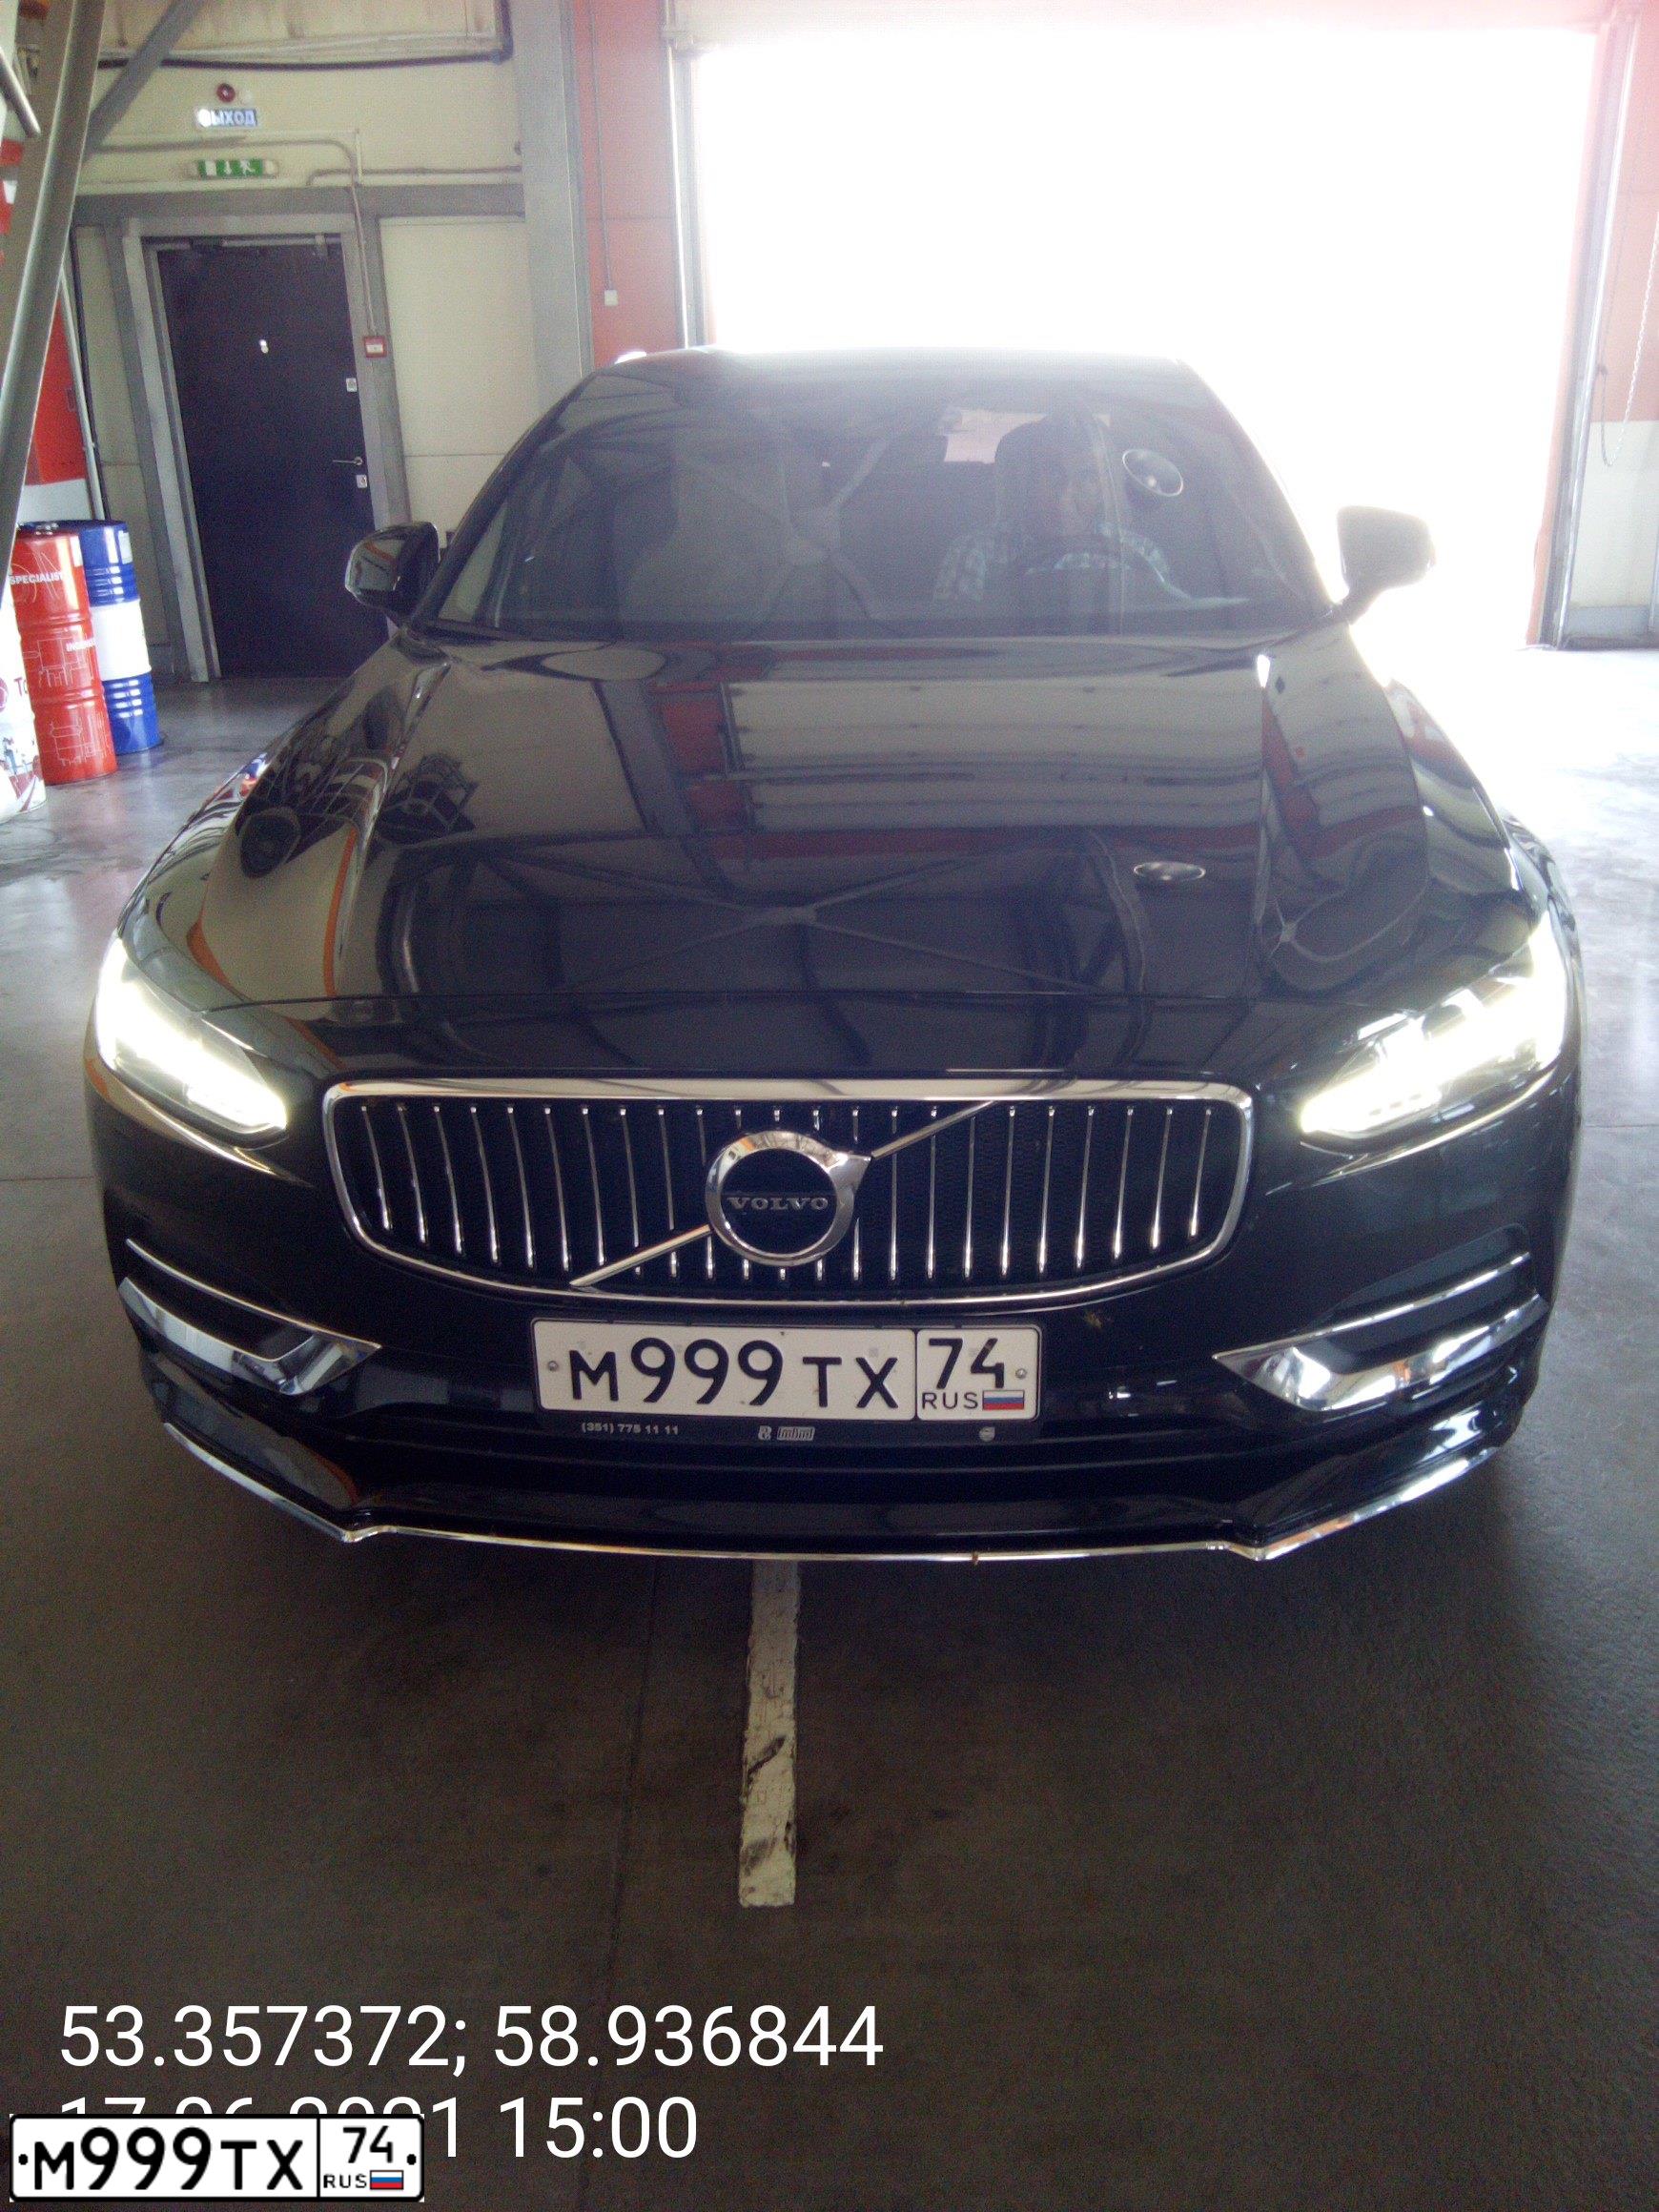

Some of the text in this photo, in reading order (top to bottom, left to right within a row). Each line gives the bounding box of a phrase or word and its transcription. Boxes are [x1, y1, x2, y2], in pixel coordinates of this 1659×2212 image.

[197, 110, 256, 127] ЫХОД
[727, 1197, 829, 1210] VOLVO
[928, 1338, 1004, 1389] 74
[922, 1392, 978, 1409] RUS
